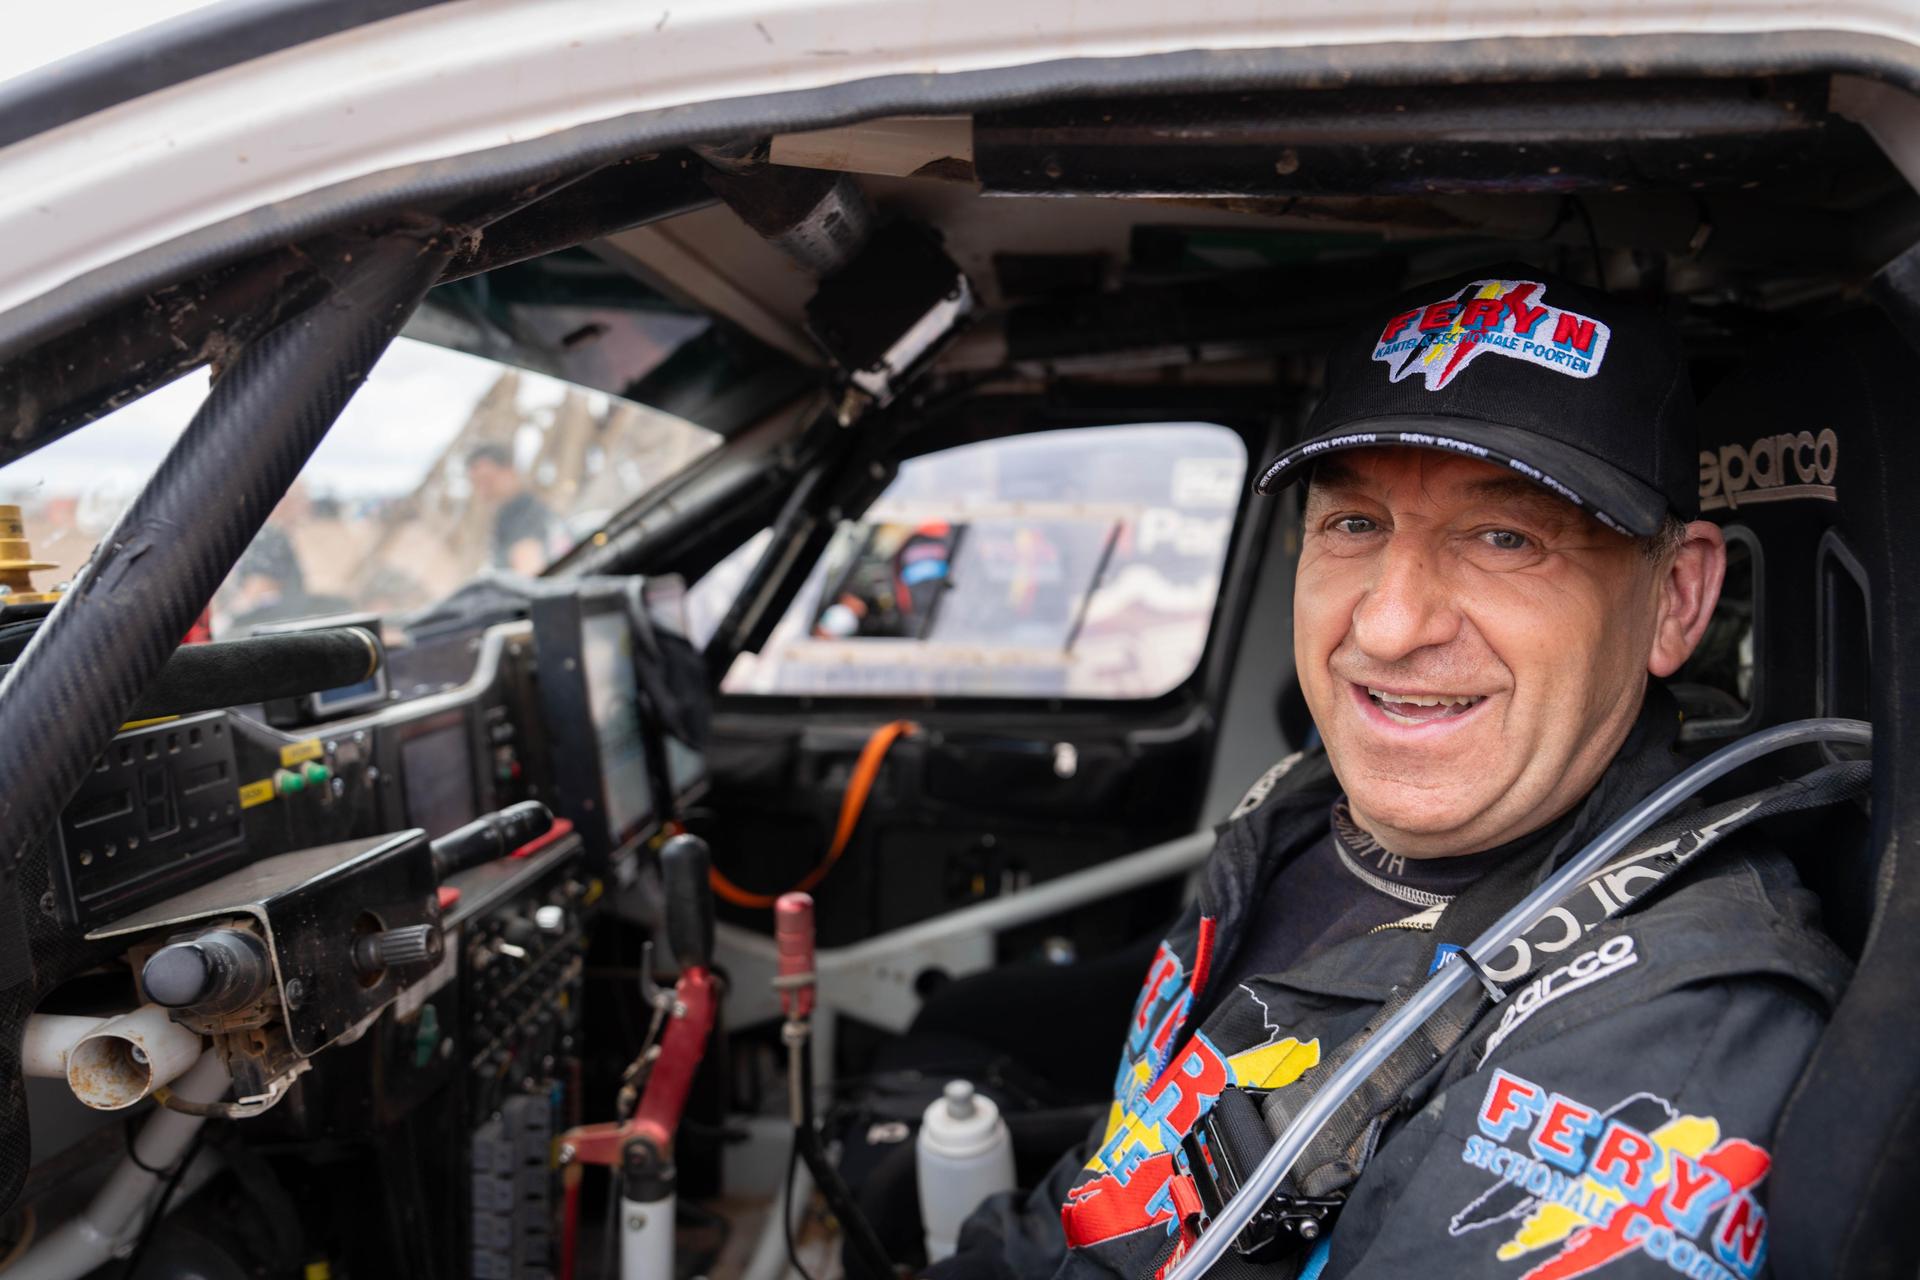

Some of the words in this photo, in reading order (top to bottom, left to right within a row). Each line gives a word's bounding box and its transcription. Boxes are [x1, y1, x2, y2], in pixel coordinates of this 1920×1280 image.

[1381, 297, 1598, 359] FERYN
[1522, 340, 1591, 374] POORTEN
[1699, 428, 1838, 509] sparco
[1462, 1134, 1619, 1228] SECTIONALE
[1477, 1067, 1768, 1280] FERYN
